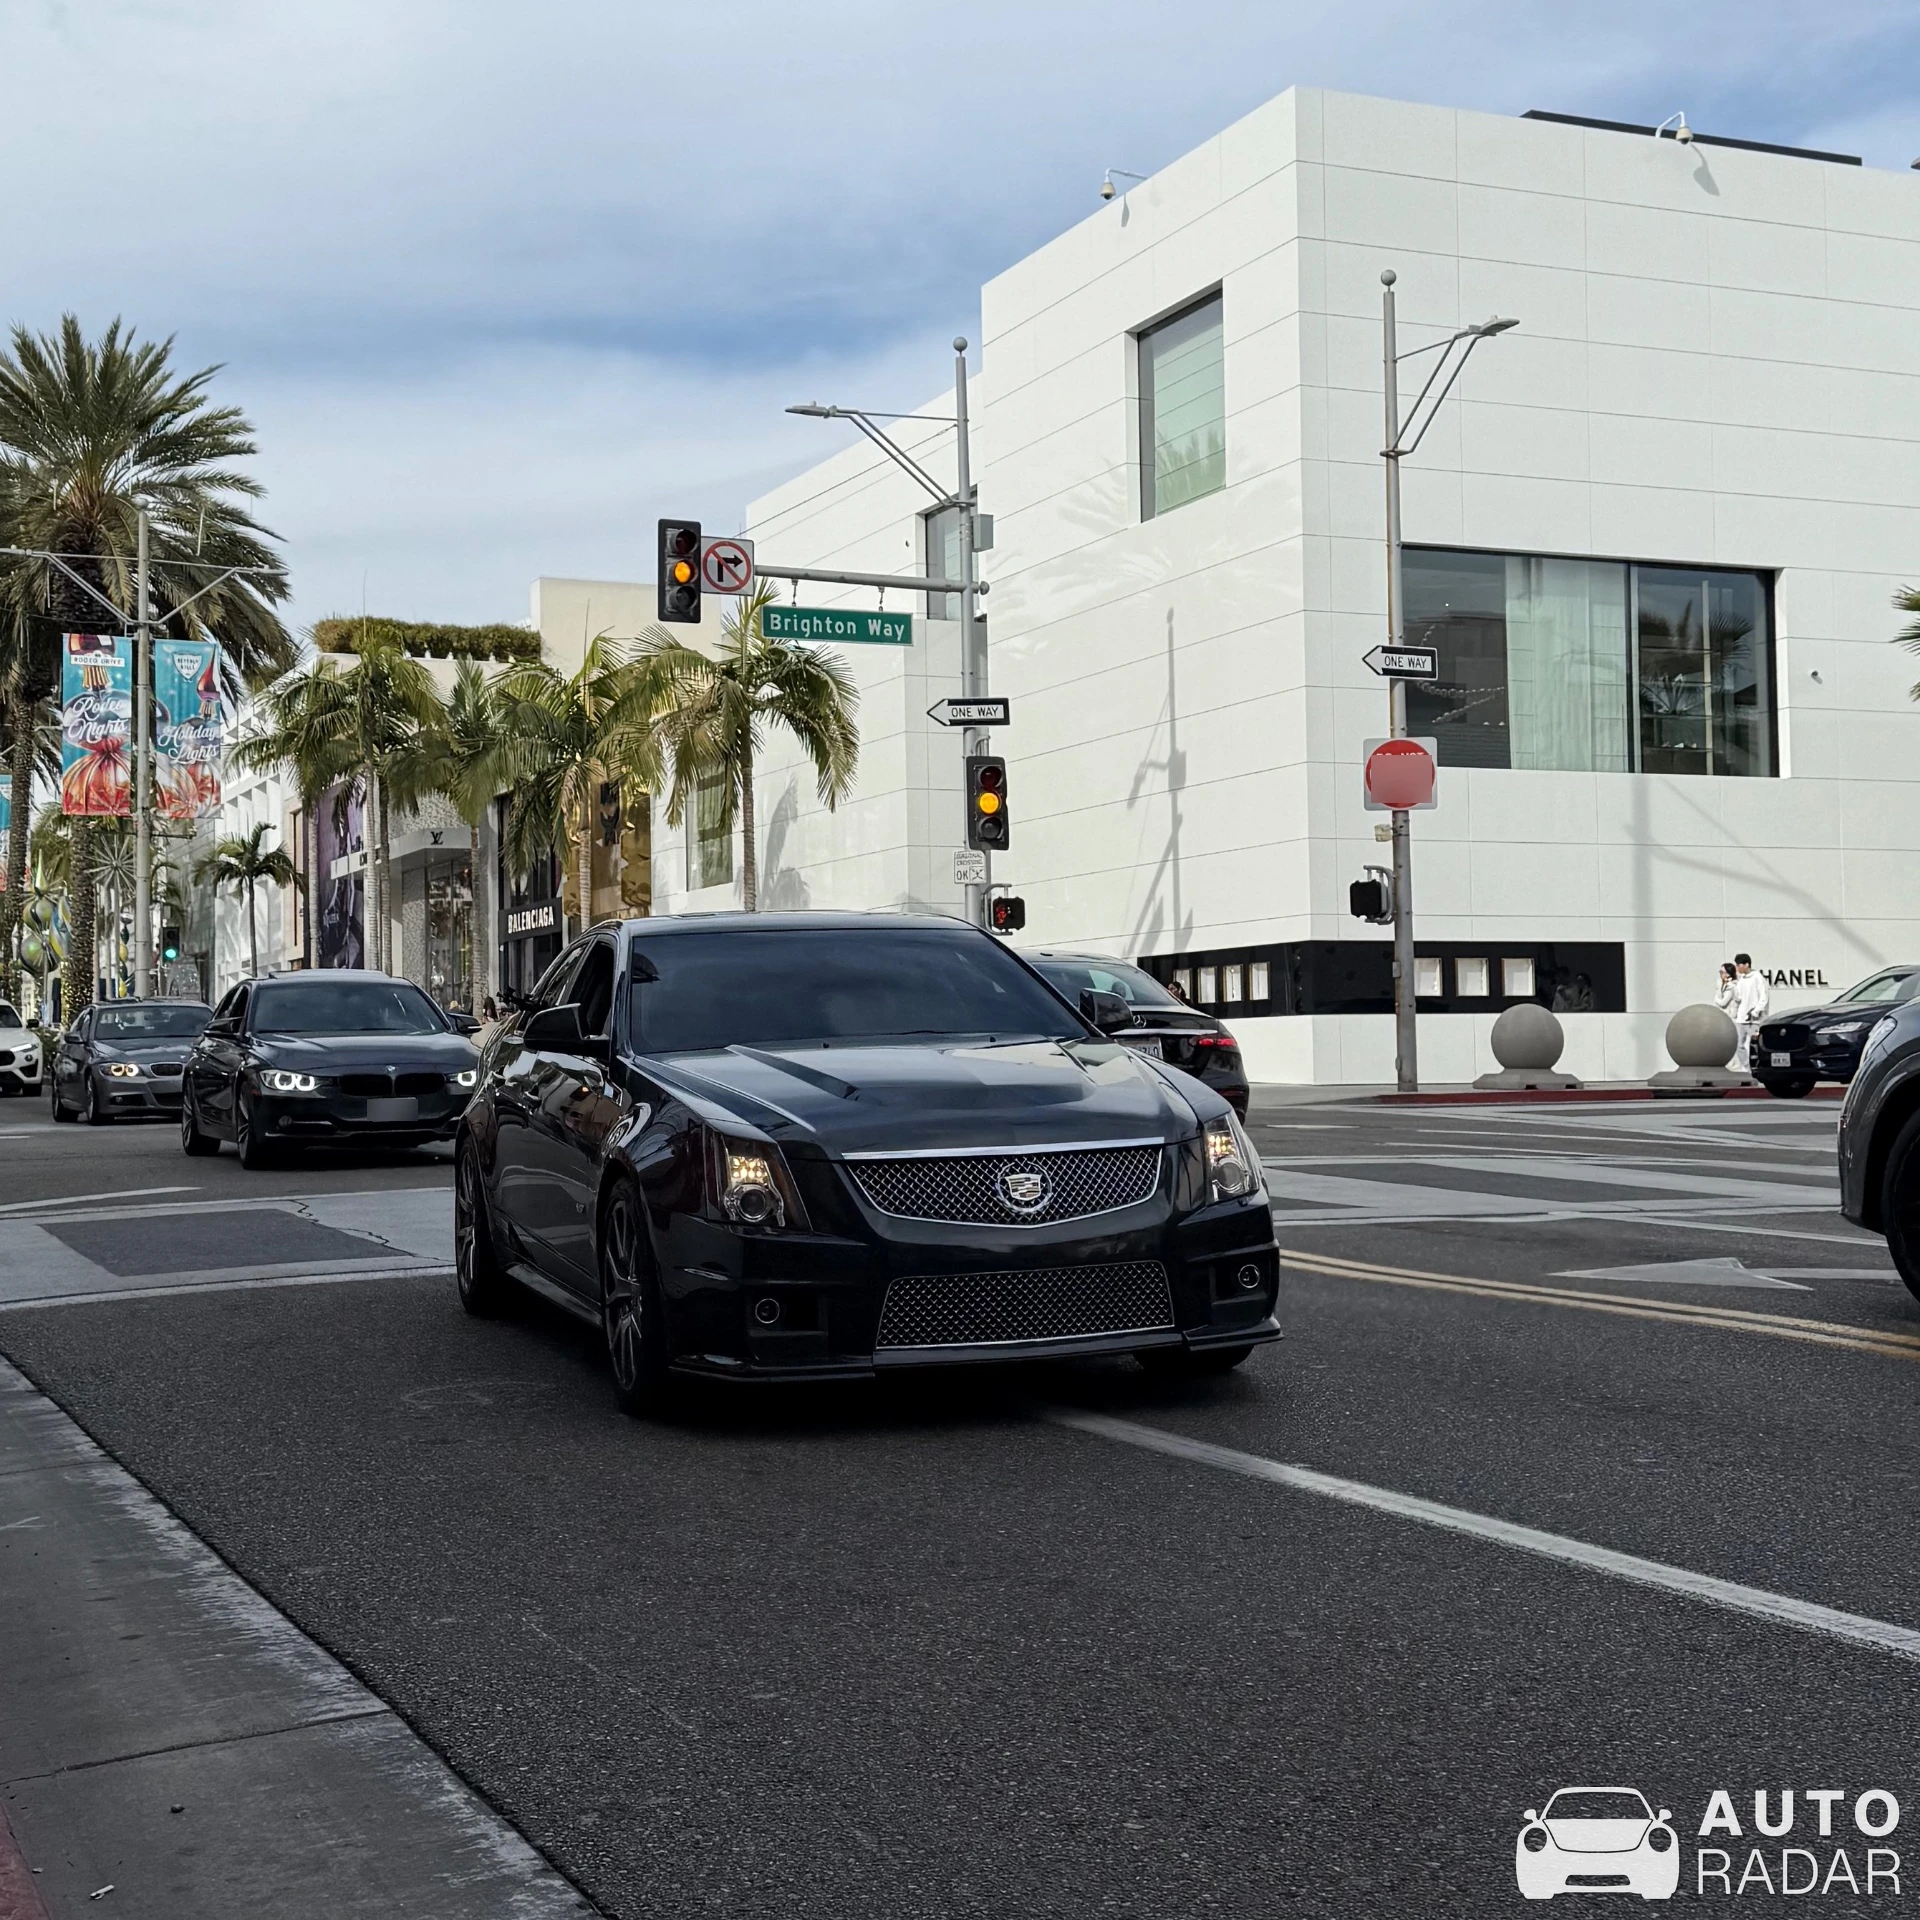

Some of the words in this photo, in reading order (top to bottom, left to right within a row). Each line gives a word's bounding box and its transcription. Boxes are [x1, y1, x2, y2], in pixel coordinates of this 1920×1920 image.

[770, 613, 857, 637] Brighton
[868, 618, 905, 642] Way
[1384, 655, 1404, 668] ONE
[1408, 656, 1427, 669] WAY
[951, 707, 973, 718] ONE
[977, 706, 999, 717] WAY
[68, 718, 129, 744] Nights
[157, 724, 216, 748] Holiday
[168, 744, 220, 765] Lights
[956, 870, 969, 881] OK
[507, 906, 555, 934] BALENCIAGA
[1759, 969, 1828, 986] HANEL
